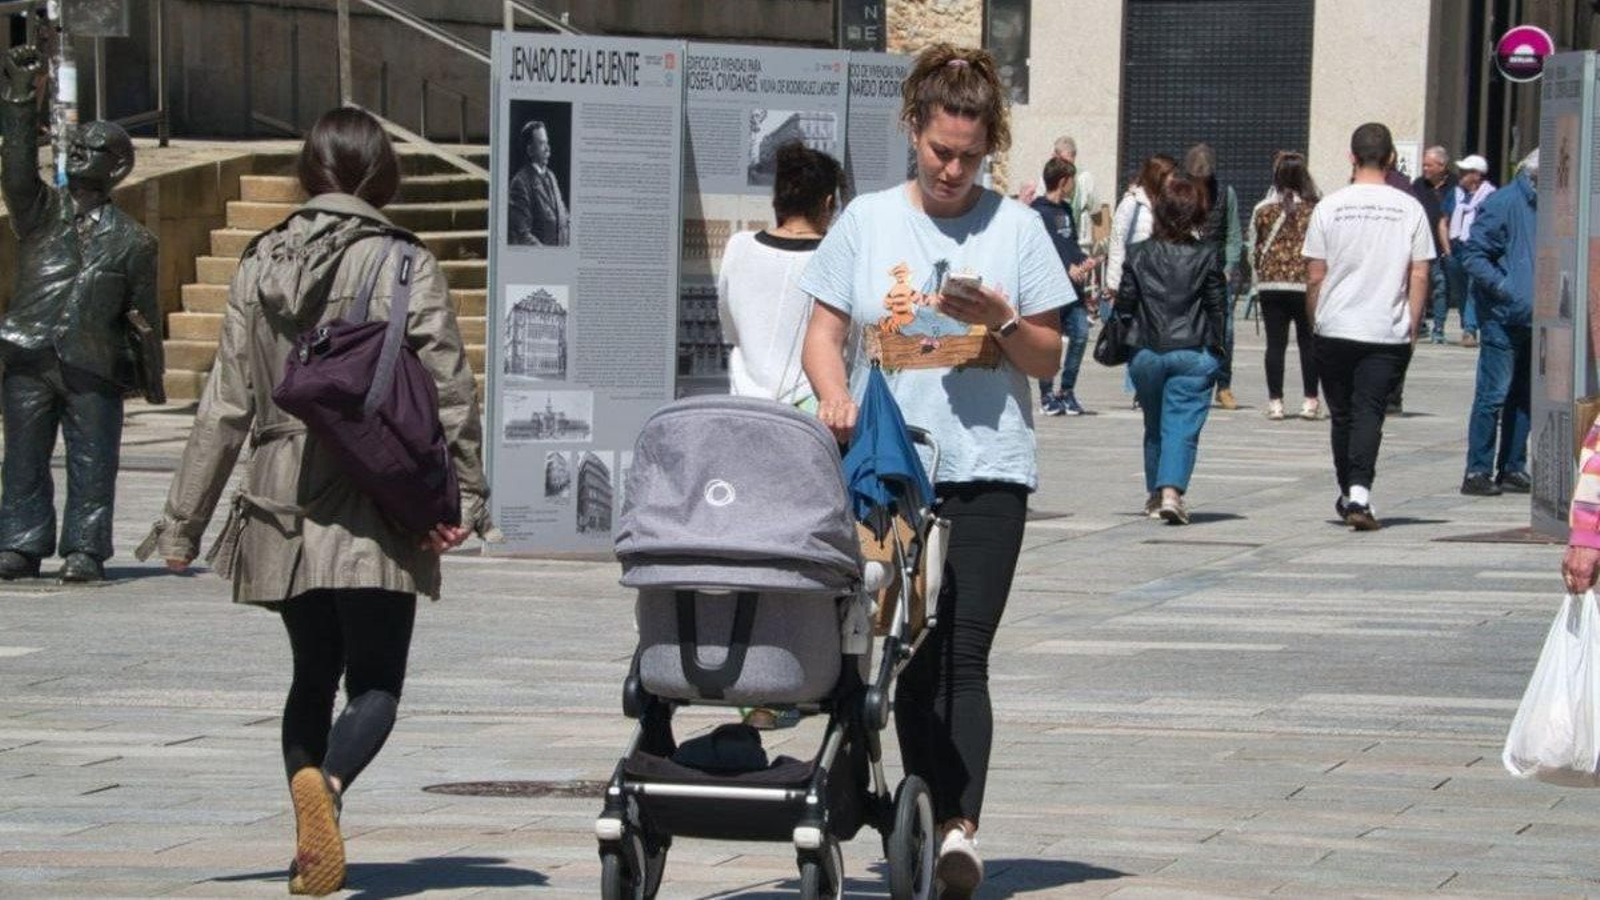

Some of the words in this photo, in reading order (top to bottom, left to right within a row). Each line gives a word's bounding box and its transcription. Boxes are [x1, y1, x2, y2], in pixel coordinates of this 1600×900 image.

[510, 46, 558, 82] JENARO
[560, 48, 577, 83] DE
[579, 49, 595, 84] LA
[596, 50, 640, 86] FUENTE
[748, 59, 762, 72] PARA
